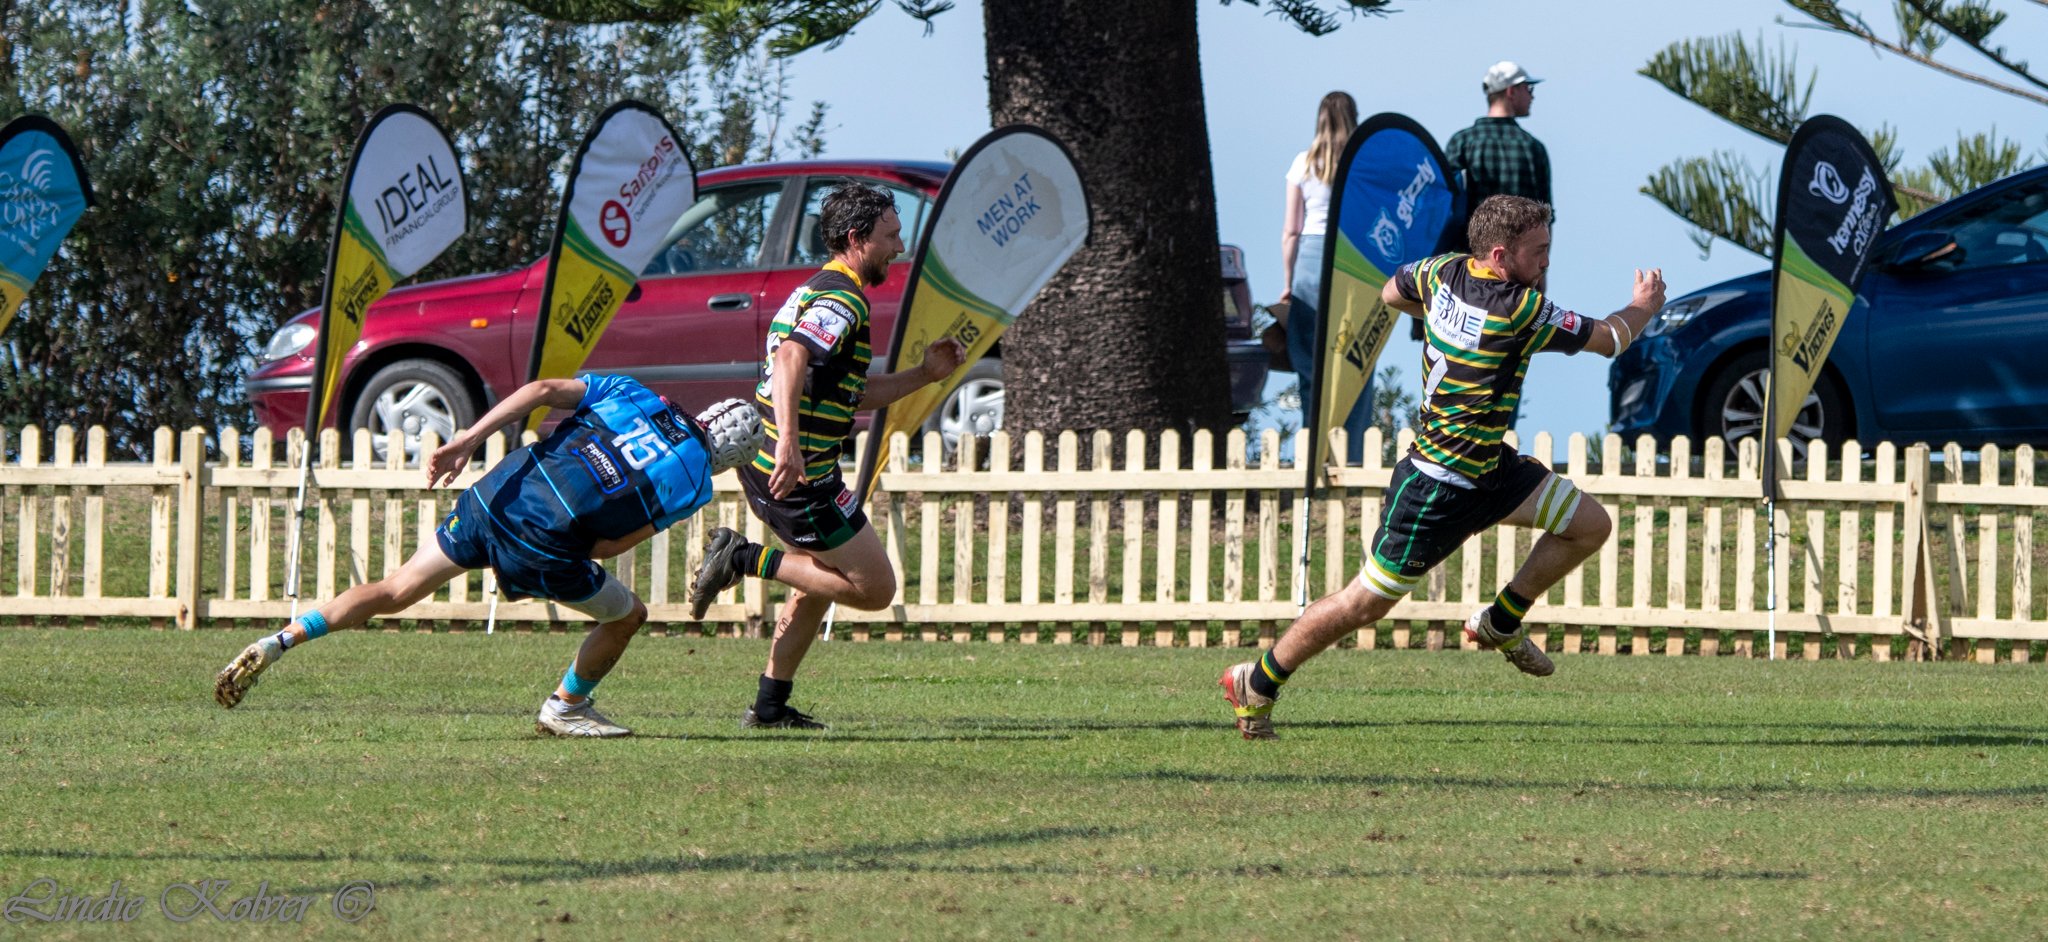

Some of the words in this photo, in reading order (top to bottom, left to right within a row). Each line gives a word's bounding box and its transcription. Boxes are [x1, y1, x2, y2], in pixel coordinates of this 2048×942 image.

[374, 154, 452, 235] IDEAL
[976, 194, 1015, 236] MEN
[1013, 172, 1034, 200] AT
[991, 195, 1042, 248] WORK
[1397, 155, 1436, 229] grizzly
[1827, 165, 1877, 255] hennessy
[564, 282, 614, 345] VIKINGS
[803, 322, 833, 341] TOOHEYS
[1345, 305, 1391, 372] VIKINGS
[1792, 306, 1836, 375] VIKINGS
[1424, 343, 1449, 411] 7
[611, 417, 671, 471] 15
